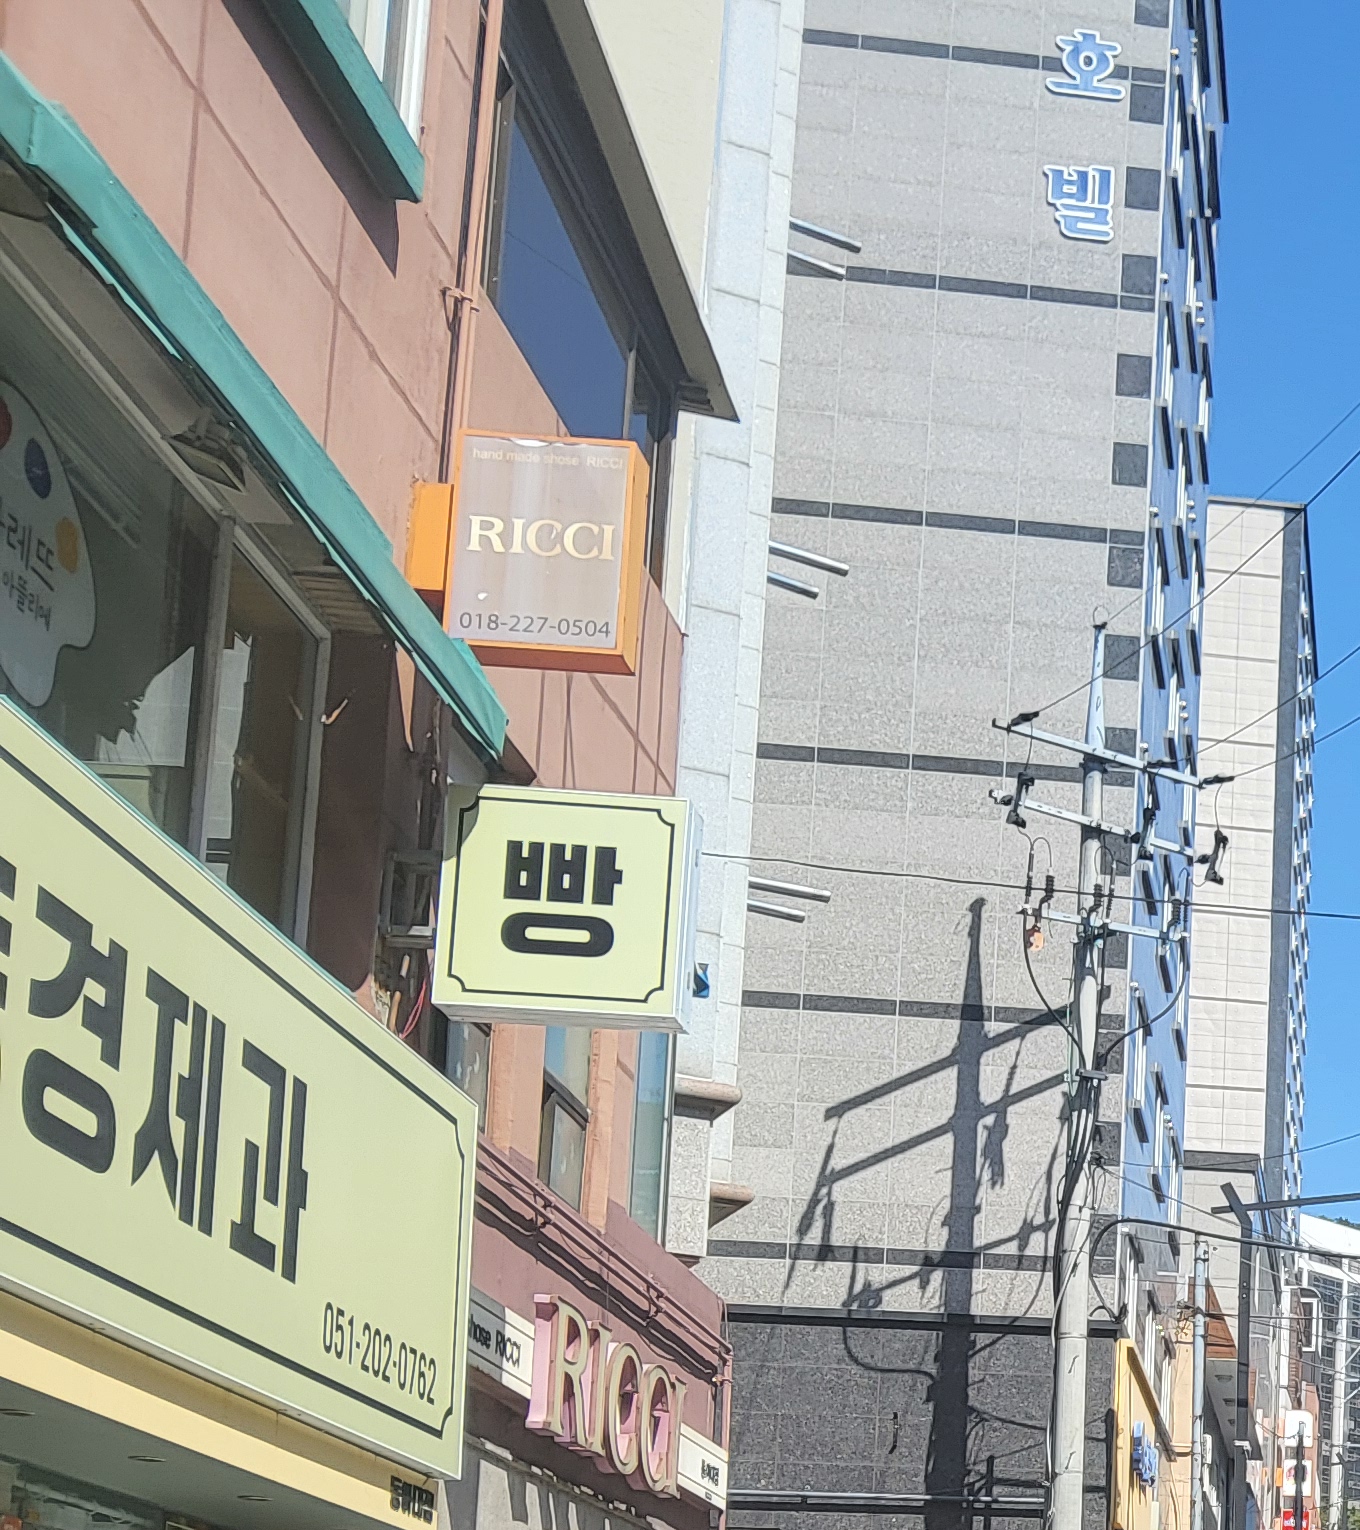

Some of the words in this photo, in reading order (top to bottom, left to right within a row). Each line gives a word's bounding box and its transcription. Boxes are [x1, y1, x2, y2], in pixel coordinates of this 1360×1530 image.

[472, 448, 503, 461] hand
[506, 450, 540, 464] made
[586, 456, 623, 469] RICCI
[466, 515, 616, 561] RICCI
[459, 612, 610, 639] 018-227-0504
[501, 839, 624, 957] 빵
[0, 858, 309, 1285] 경제과
[322, 1300, 437, 1405] 051-202-0762
[495, 1329, 522, 1369] RICCI
[526, 1293, 688, 1499] RICCI
